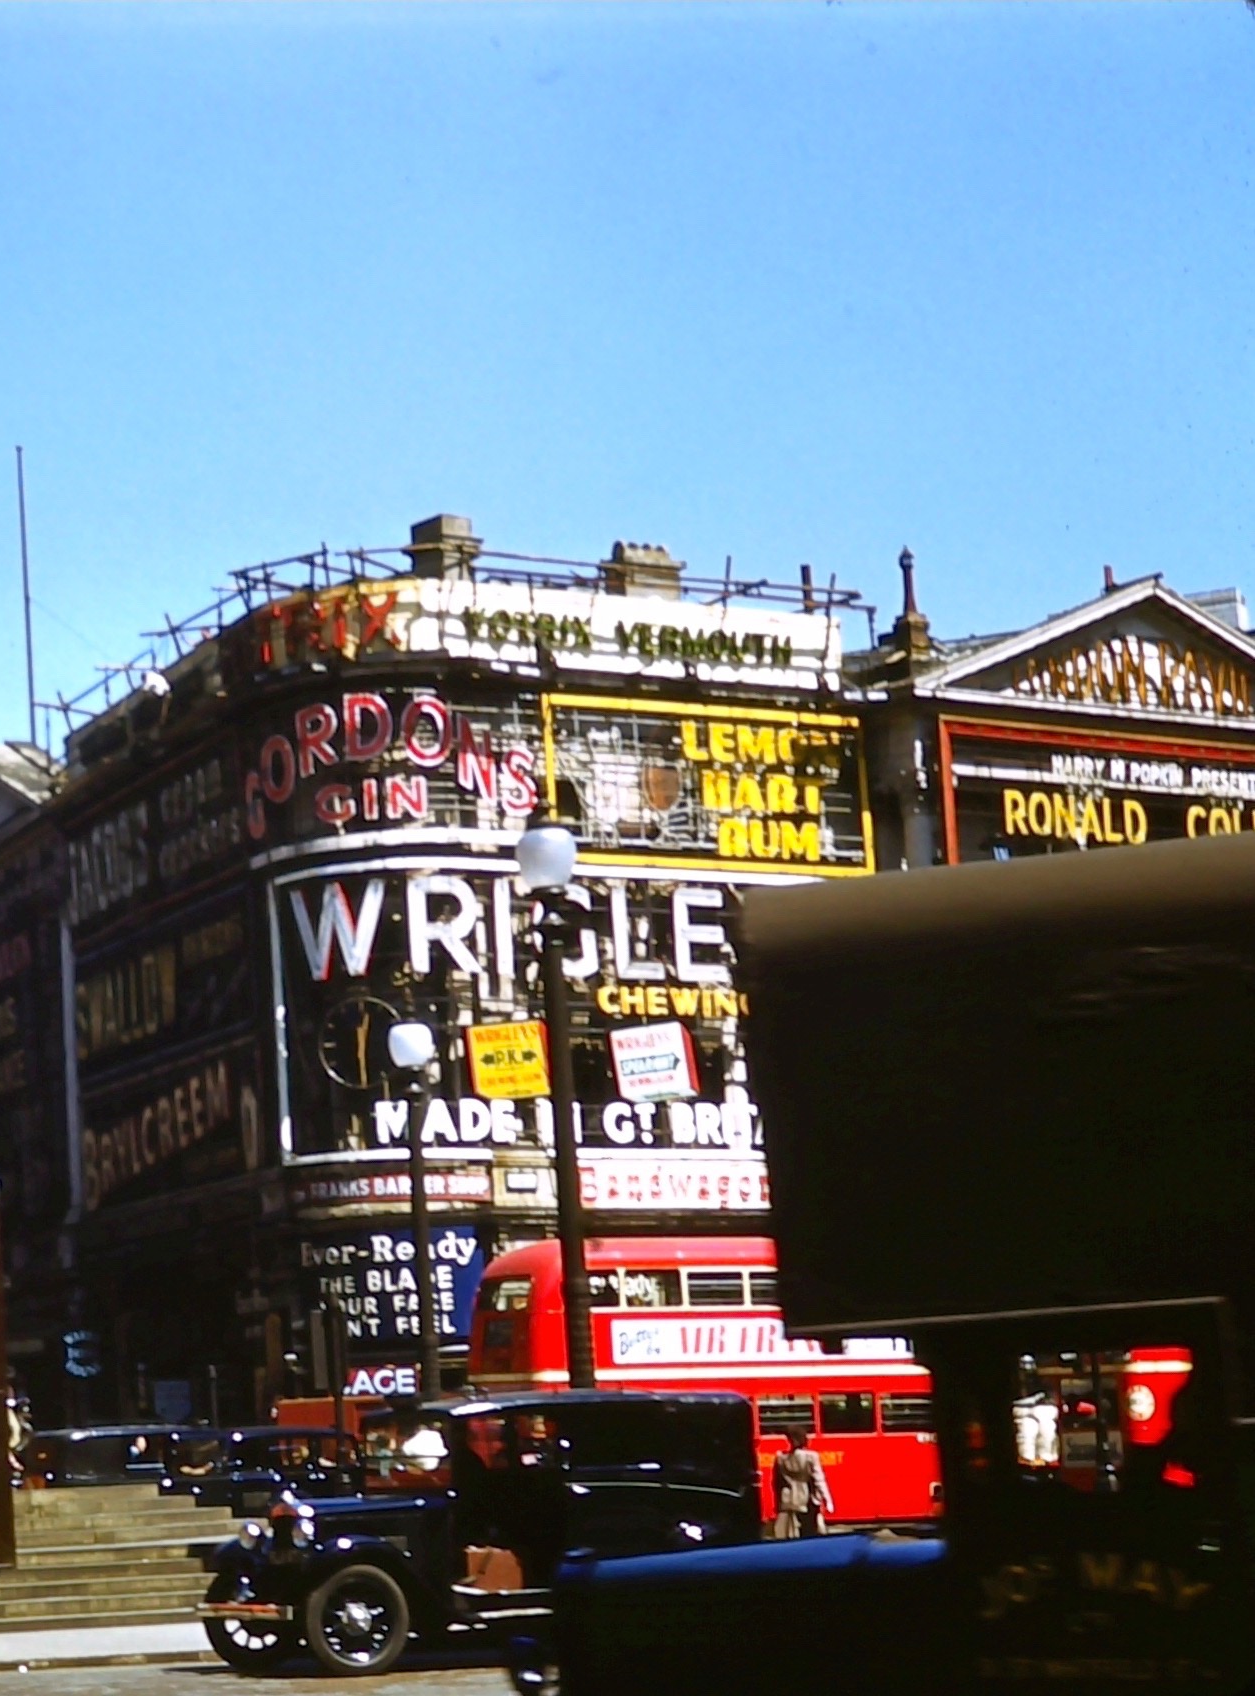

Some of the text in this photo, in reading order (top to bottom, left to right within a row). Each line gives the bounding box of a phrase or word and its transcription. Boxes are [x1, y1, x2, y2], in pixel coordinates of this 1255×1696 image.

[614, 619, 793, 668] VERMOUTH
[702, 769, 833, 815] HART
[1050, 752, 1106, 785] HARRY
[1130, 760, 1184, 788] POPKIN
[315, 775, 429, 824] GIN
[1003, 787, 1148, 846] RONALD
[717, 817, 822, 862] RUM
[596, 985, 749, 1019] CHEWIN
[376, 1099, 523, 1145] MADE
[670, 1101, 764, 1146] BRIT
[373, 1174, 443, 1198] BARER
[365, 1264, 454, 1294] BLAE
[342, 1367, 417, 1396] AGE
